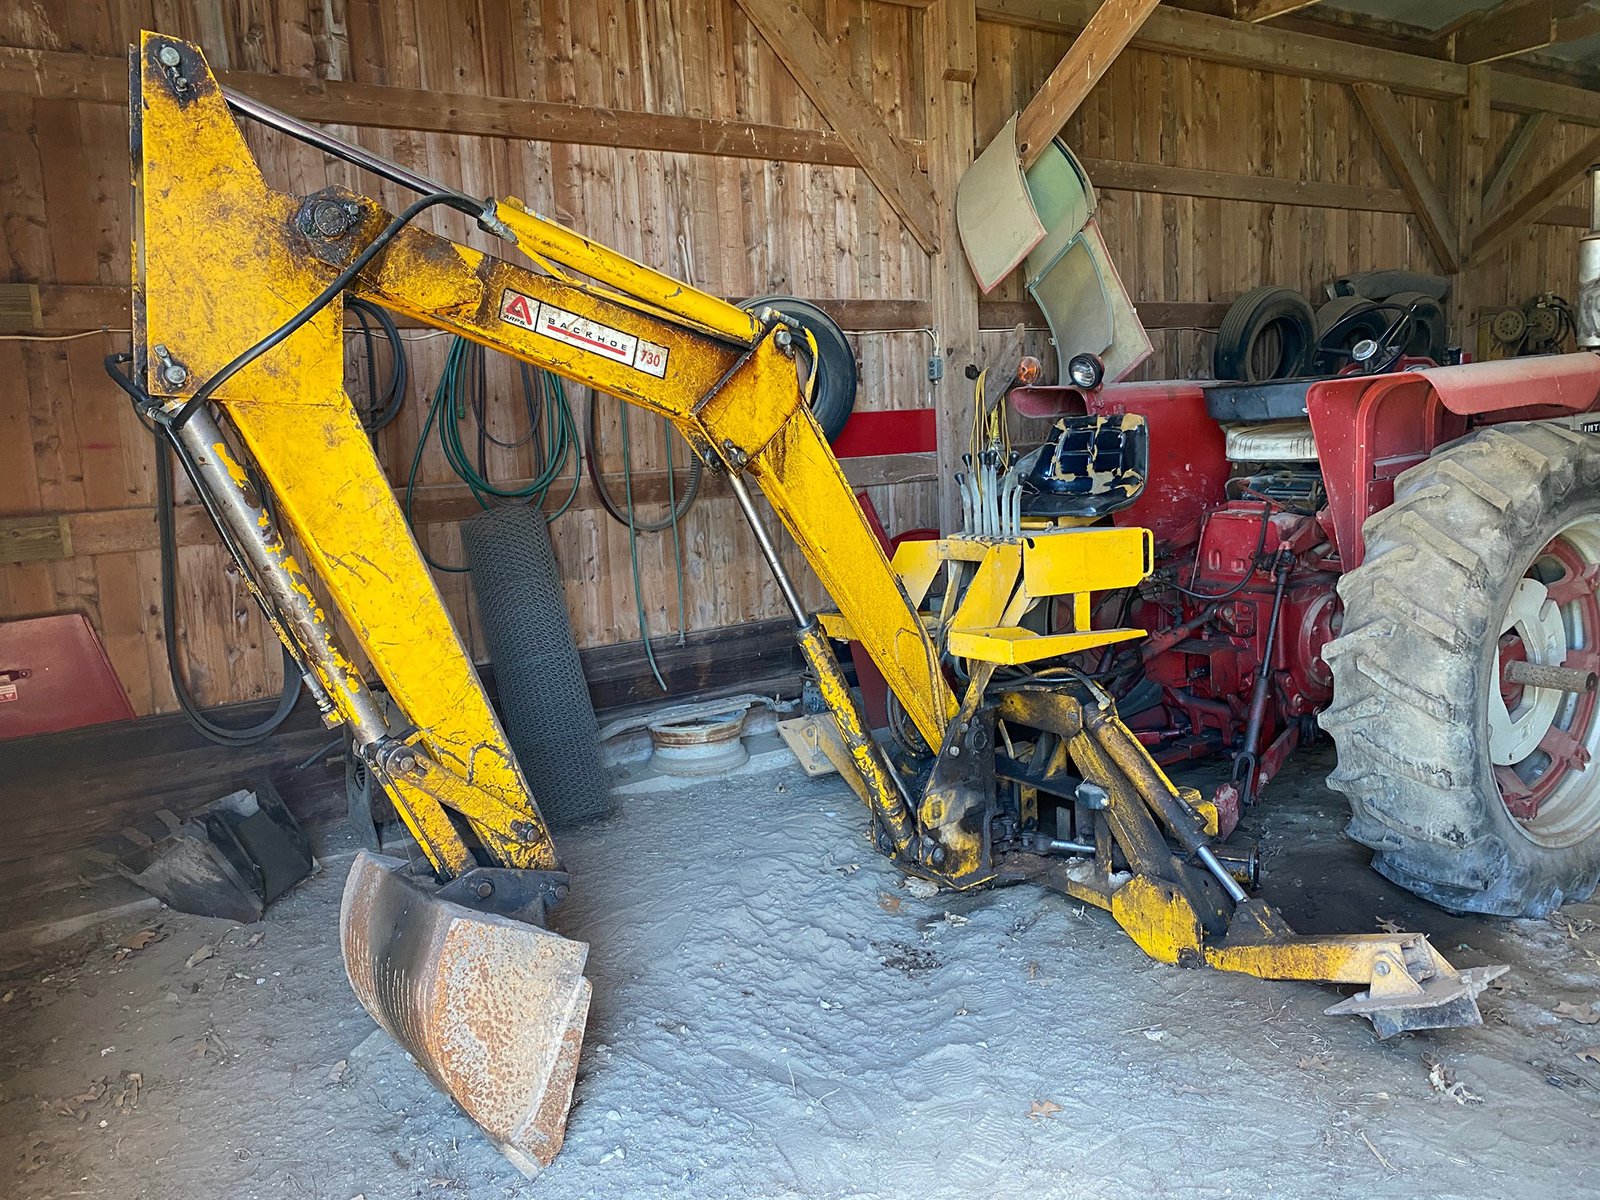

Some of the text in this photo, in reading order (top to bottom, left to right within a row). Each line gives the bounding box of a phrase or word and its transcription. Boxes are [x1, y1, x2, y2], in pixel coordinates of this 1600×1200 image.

[503, 314, 526, 326] ARPS
[548, 317, 661, 367] BACKHOE 730
